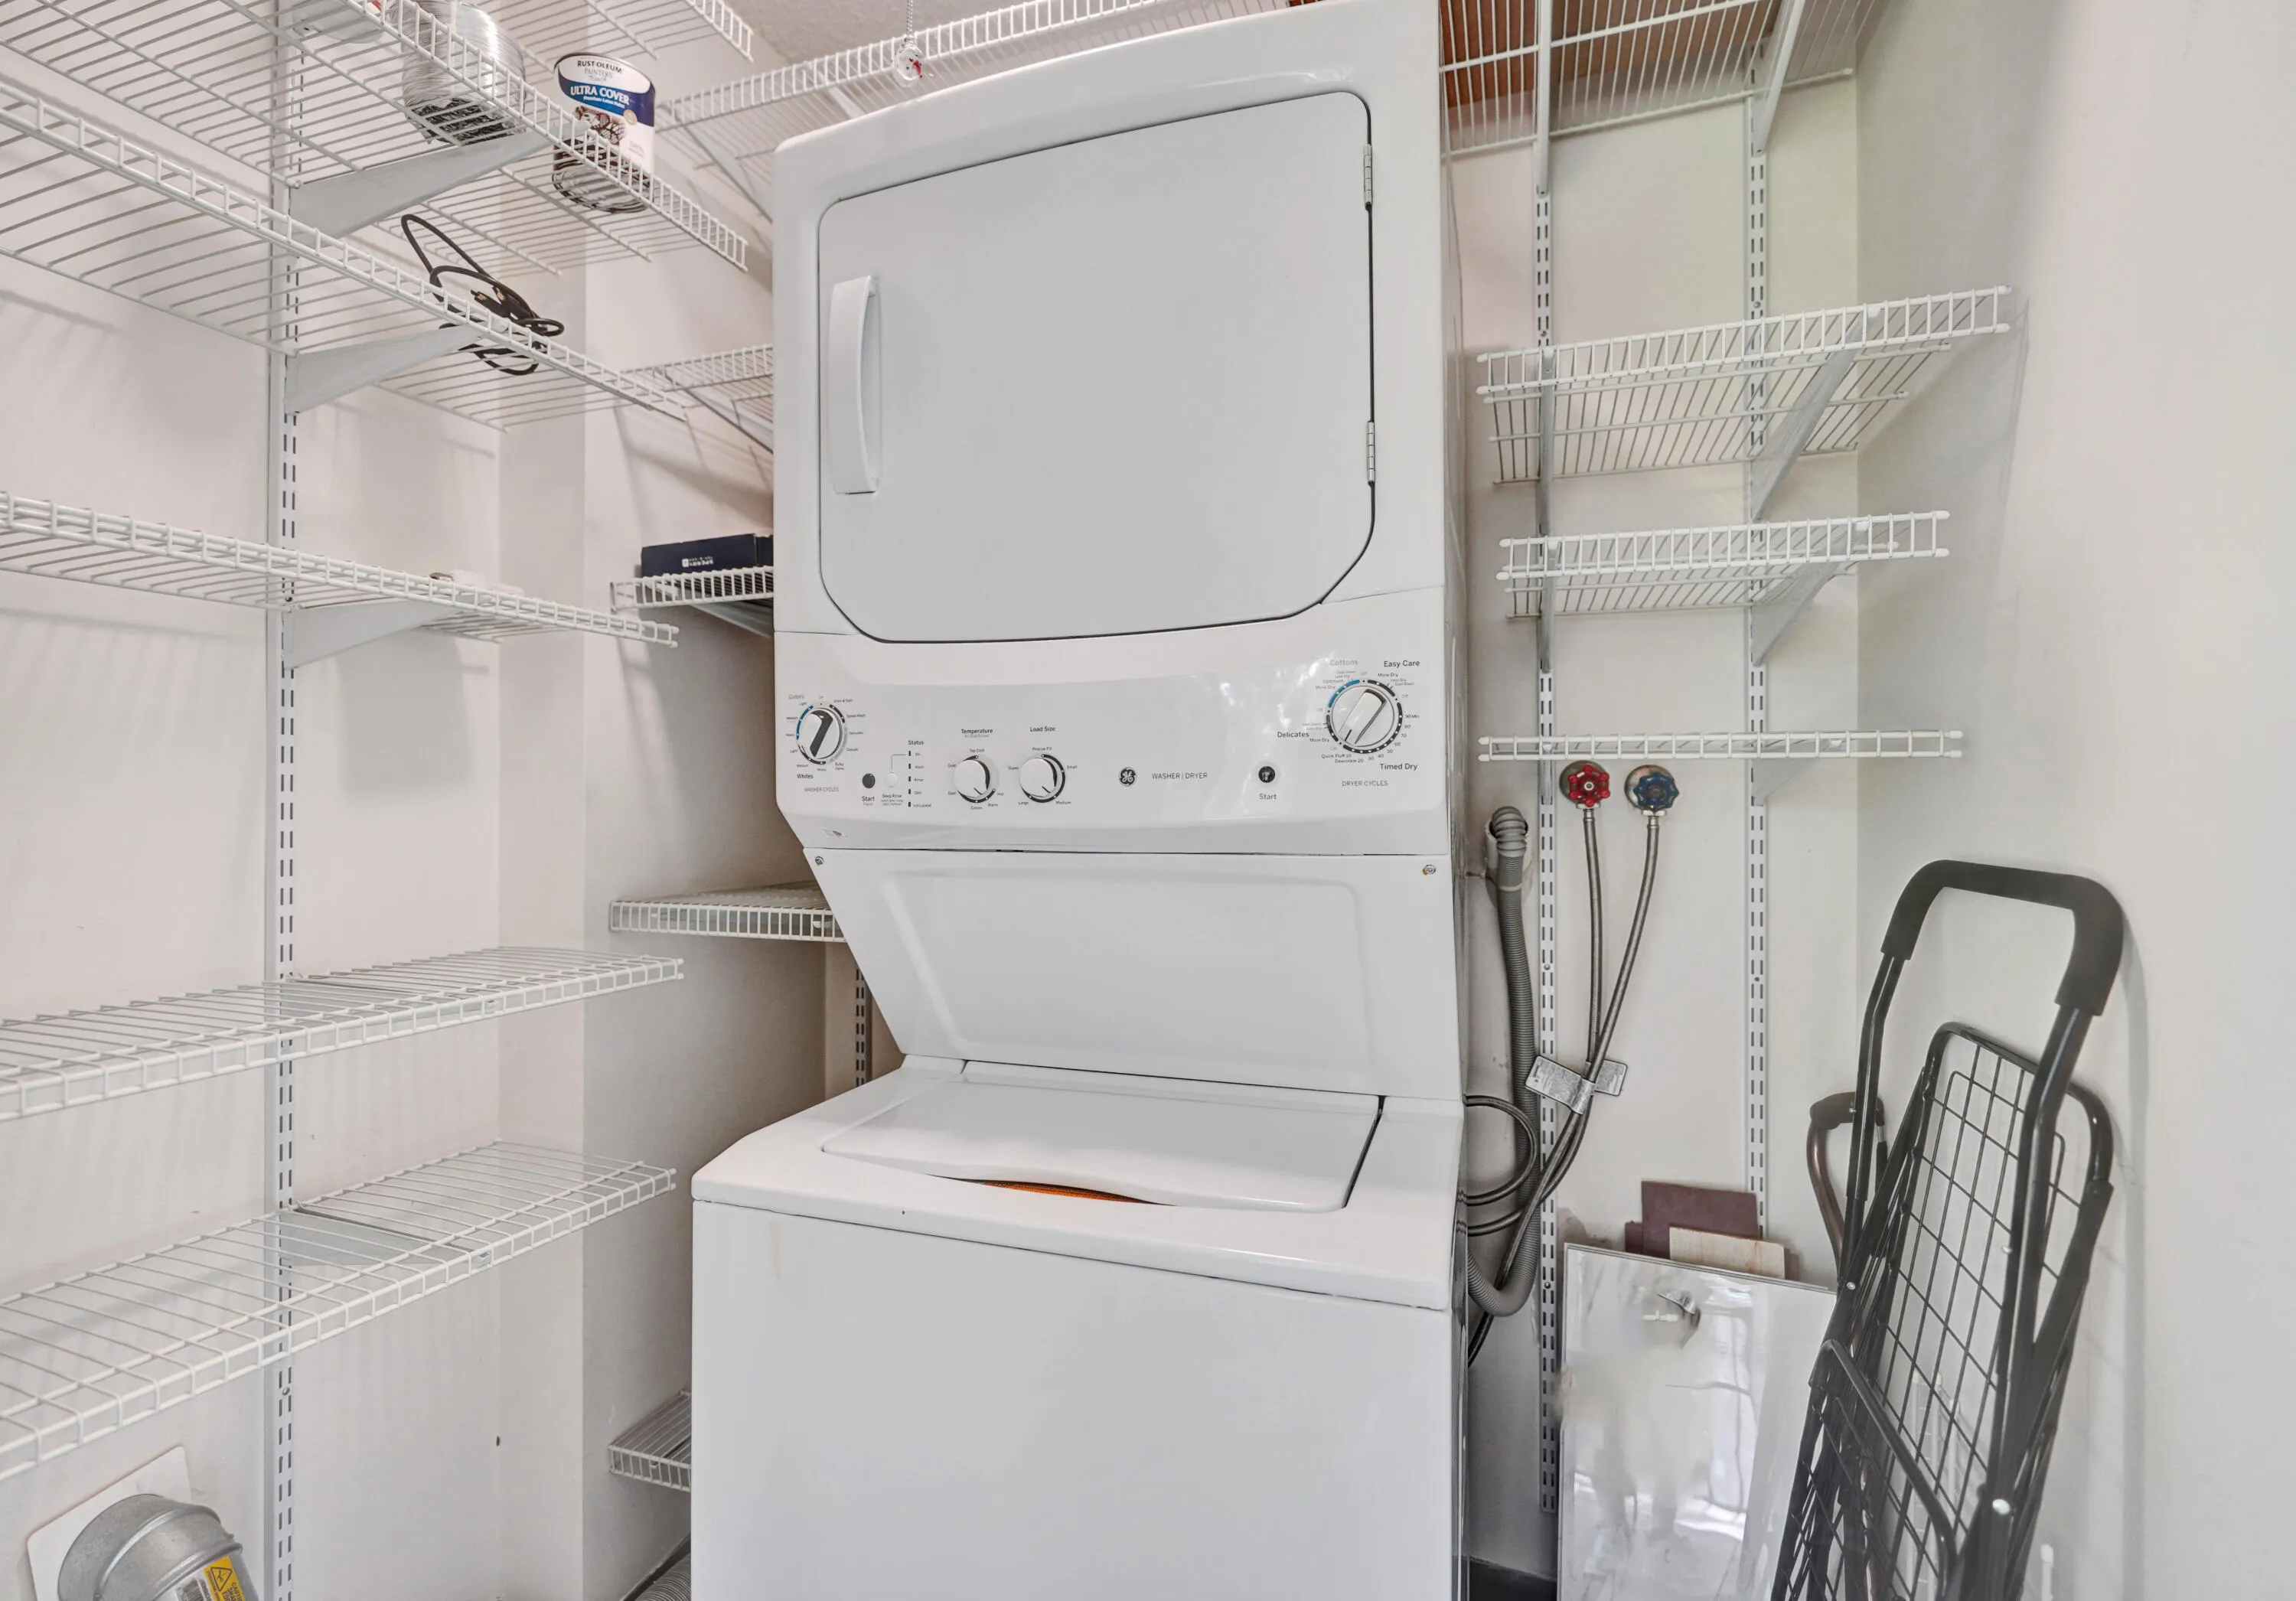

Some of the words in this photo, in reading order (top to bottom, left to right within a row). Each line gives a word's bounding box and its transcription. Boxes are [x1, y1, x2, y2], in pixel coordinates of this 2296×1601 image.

[570, 86, 598, 96] ULTRA
[599, 87, 630, 105] COVER
[1384, 660, 1401, 669] Easy
[1404, 763, 1418, 771] Dry
[1120, 768, 1137, 785] GE
